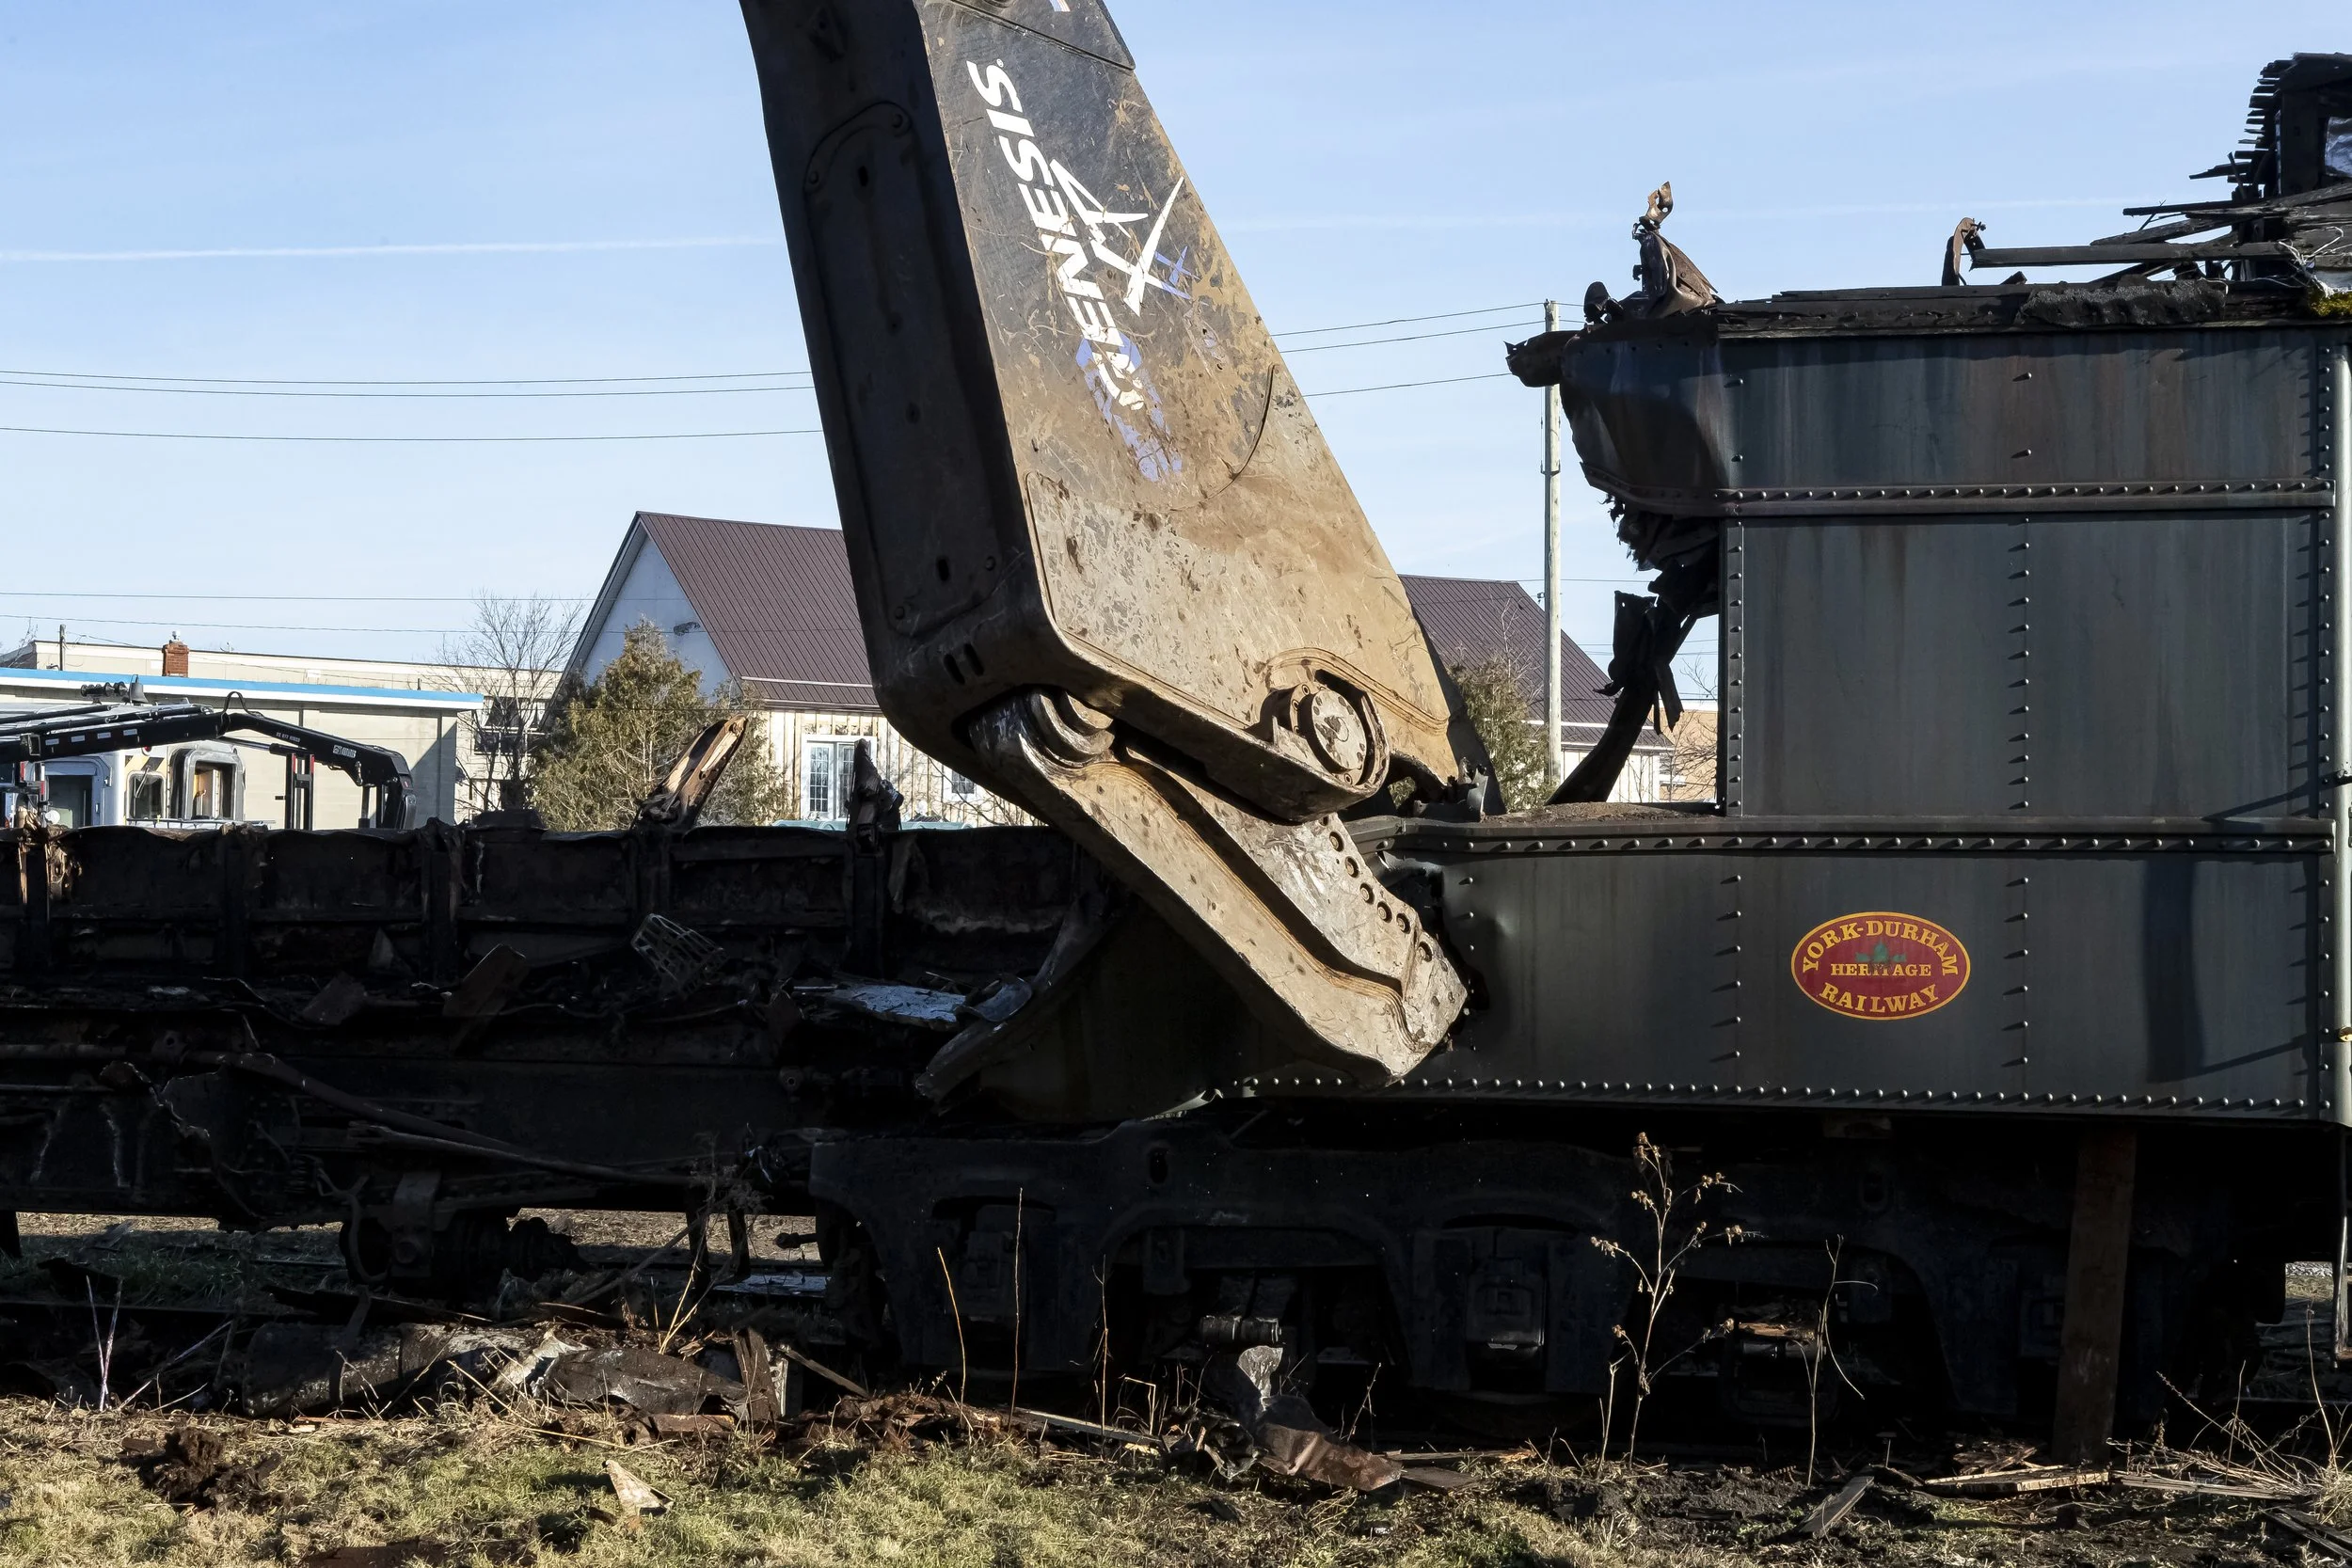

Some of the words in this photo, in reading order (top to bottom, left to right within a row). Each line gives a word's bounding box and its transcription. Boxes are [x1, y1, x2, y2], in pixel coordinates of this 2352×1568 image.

[966, 60, 1143, 410] GENESIS
[1803, 920, 1958, 975] YORK-DURHAM
[1830, 963, 1931, 976] HERITAGE
[1819, 982, 1939, 1013] RAILWAY
